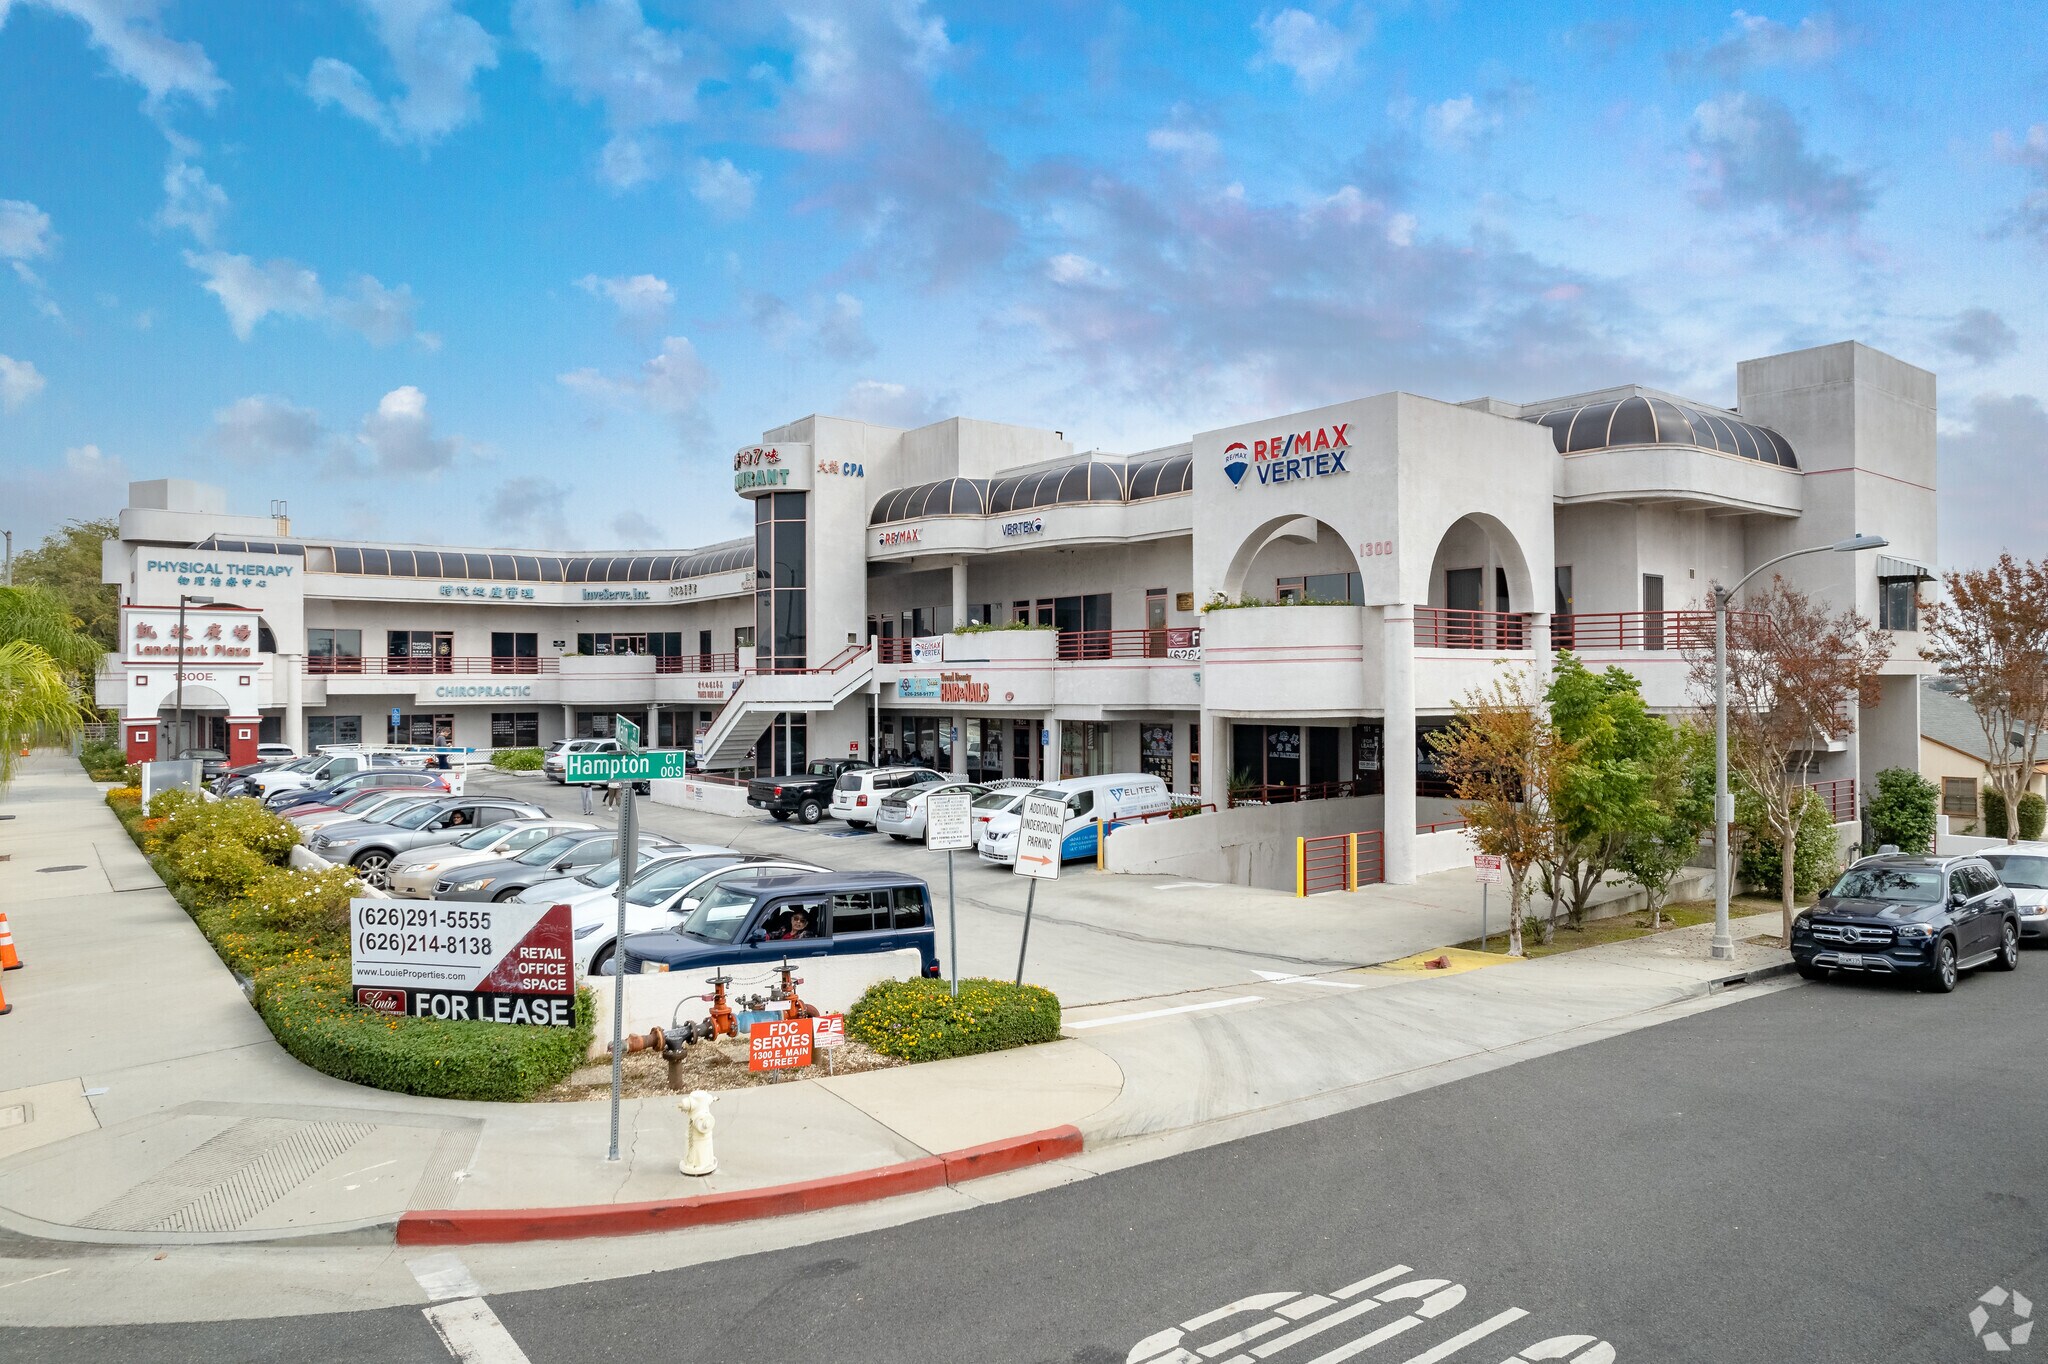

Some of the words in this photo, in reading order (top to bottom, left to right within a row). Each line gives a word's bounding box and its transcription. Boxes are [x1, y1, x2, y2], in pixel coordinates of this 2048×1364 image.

[1254, 423, 1349, 462] RE/MAX
[1225, 453, 1247, 463] RE/MAX
[843, 462, 864, 477] CPA
[1256, 450, 1346, 485] VERTEX
[1002, 520, 1034, 536] VERTEX
[885, 528, 919, 545] RE/MAX
[1360, 540, 1393, 557] 1300
[147, 560, 223, 575] PHYSICAL
[227, 563, 294, 577] THERAPY
[136, 643, 208, 657] Landmark
[213, 644, 251, 657] Plaza
[436, 685, 531, 698] CHIROPRACTIC
[665, 753, 677, 764] CT
[569, 755, 649, 779] Hampton
[1125, 786, 1157, 796] ELITEK
[1029, 802, 1059, 819] ADDITIONAL
[1022, 818, 1062, 836] UNDERGROUND
[1027, 835, 1053, 850] PARKING
[358, 907, 491, 930] (626)291-5555
[359, 932, 492, 956] (626)214-8138
[520, 947, 566, 960] RETAIL
[356, 967, 466, 981] www.LouieProperties.com
[518, 962, 566, 976] OFFICE
[523, 978, 567, 991] SPACE
[416, 993, 469, 1020] FOR
[478, 996, 569, 1026] LEASE
[770, 1022, 799, 1036] FDC
[753, 1034, 810, 1051] SERVES
[753, 1050, 773, 1060] 1300
[775, 1050, 783, 1059] E.
[786, 1047, 809, 1057] MAIN
[762, 1056, 799, 1068] STREET
